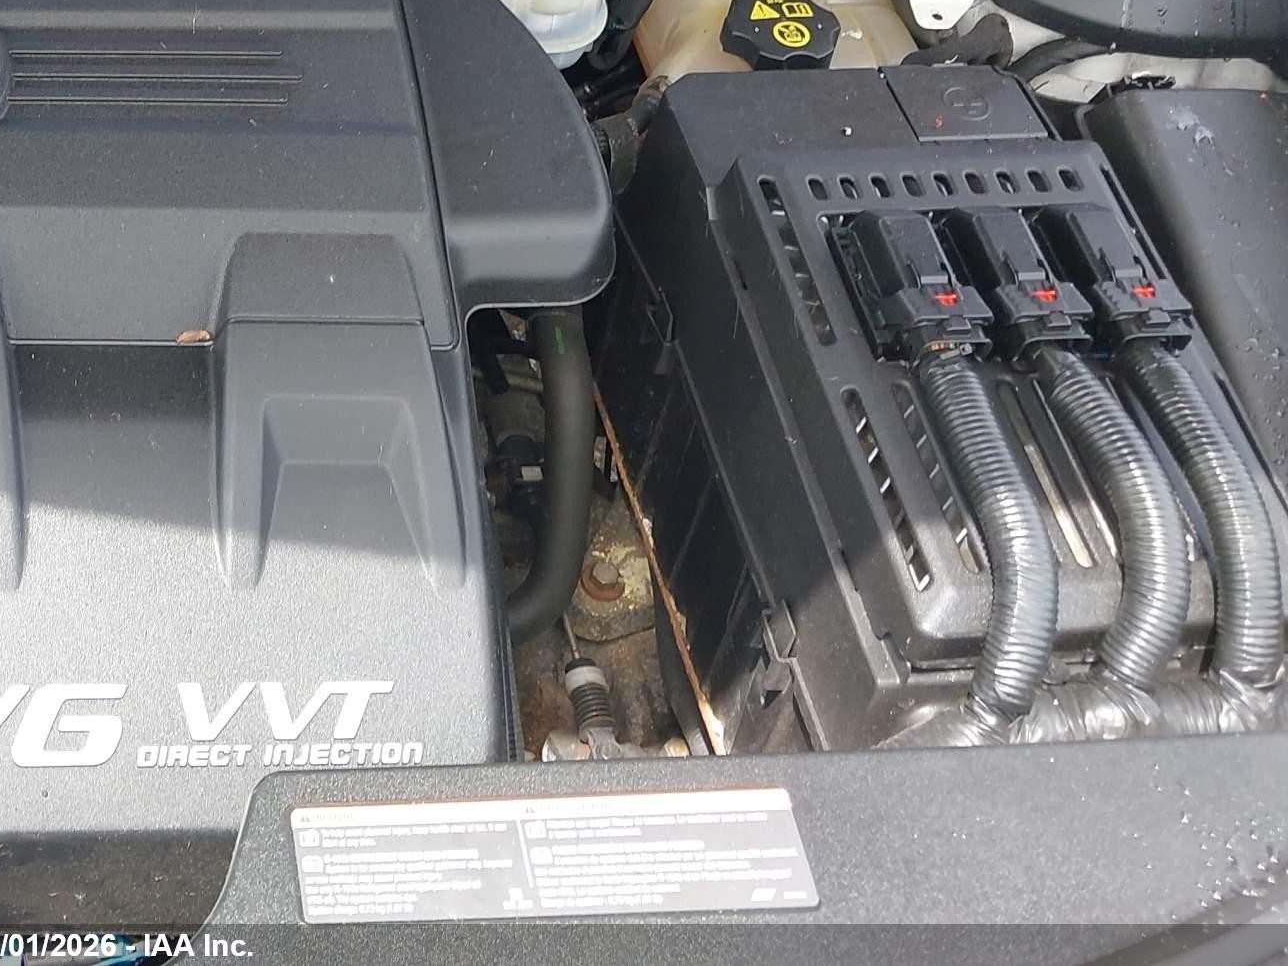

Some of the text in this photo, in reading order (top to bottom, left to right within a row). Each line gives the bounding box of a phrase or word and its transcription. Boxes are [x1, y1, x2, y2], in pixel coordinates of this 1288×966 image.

[177, 681, 395, 742] VVT
[137, 742, 424, 768] DIRECT INJECTION
